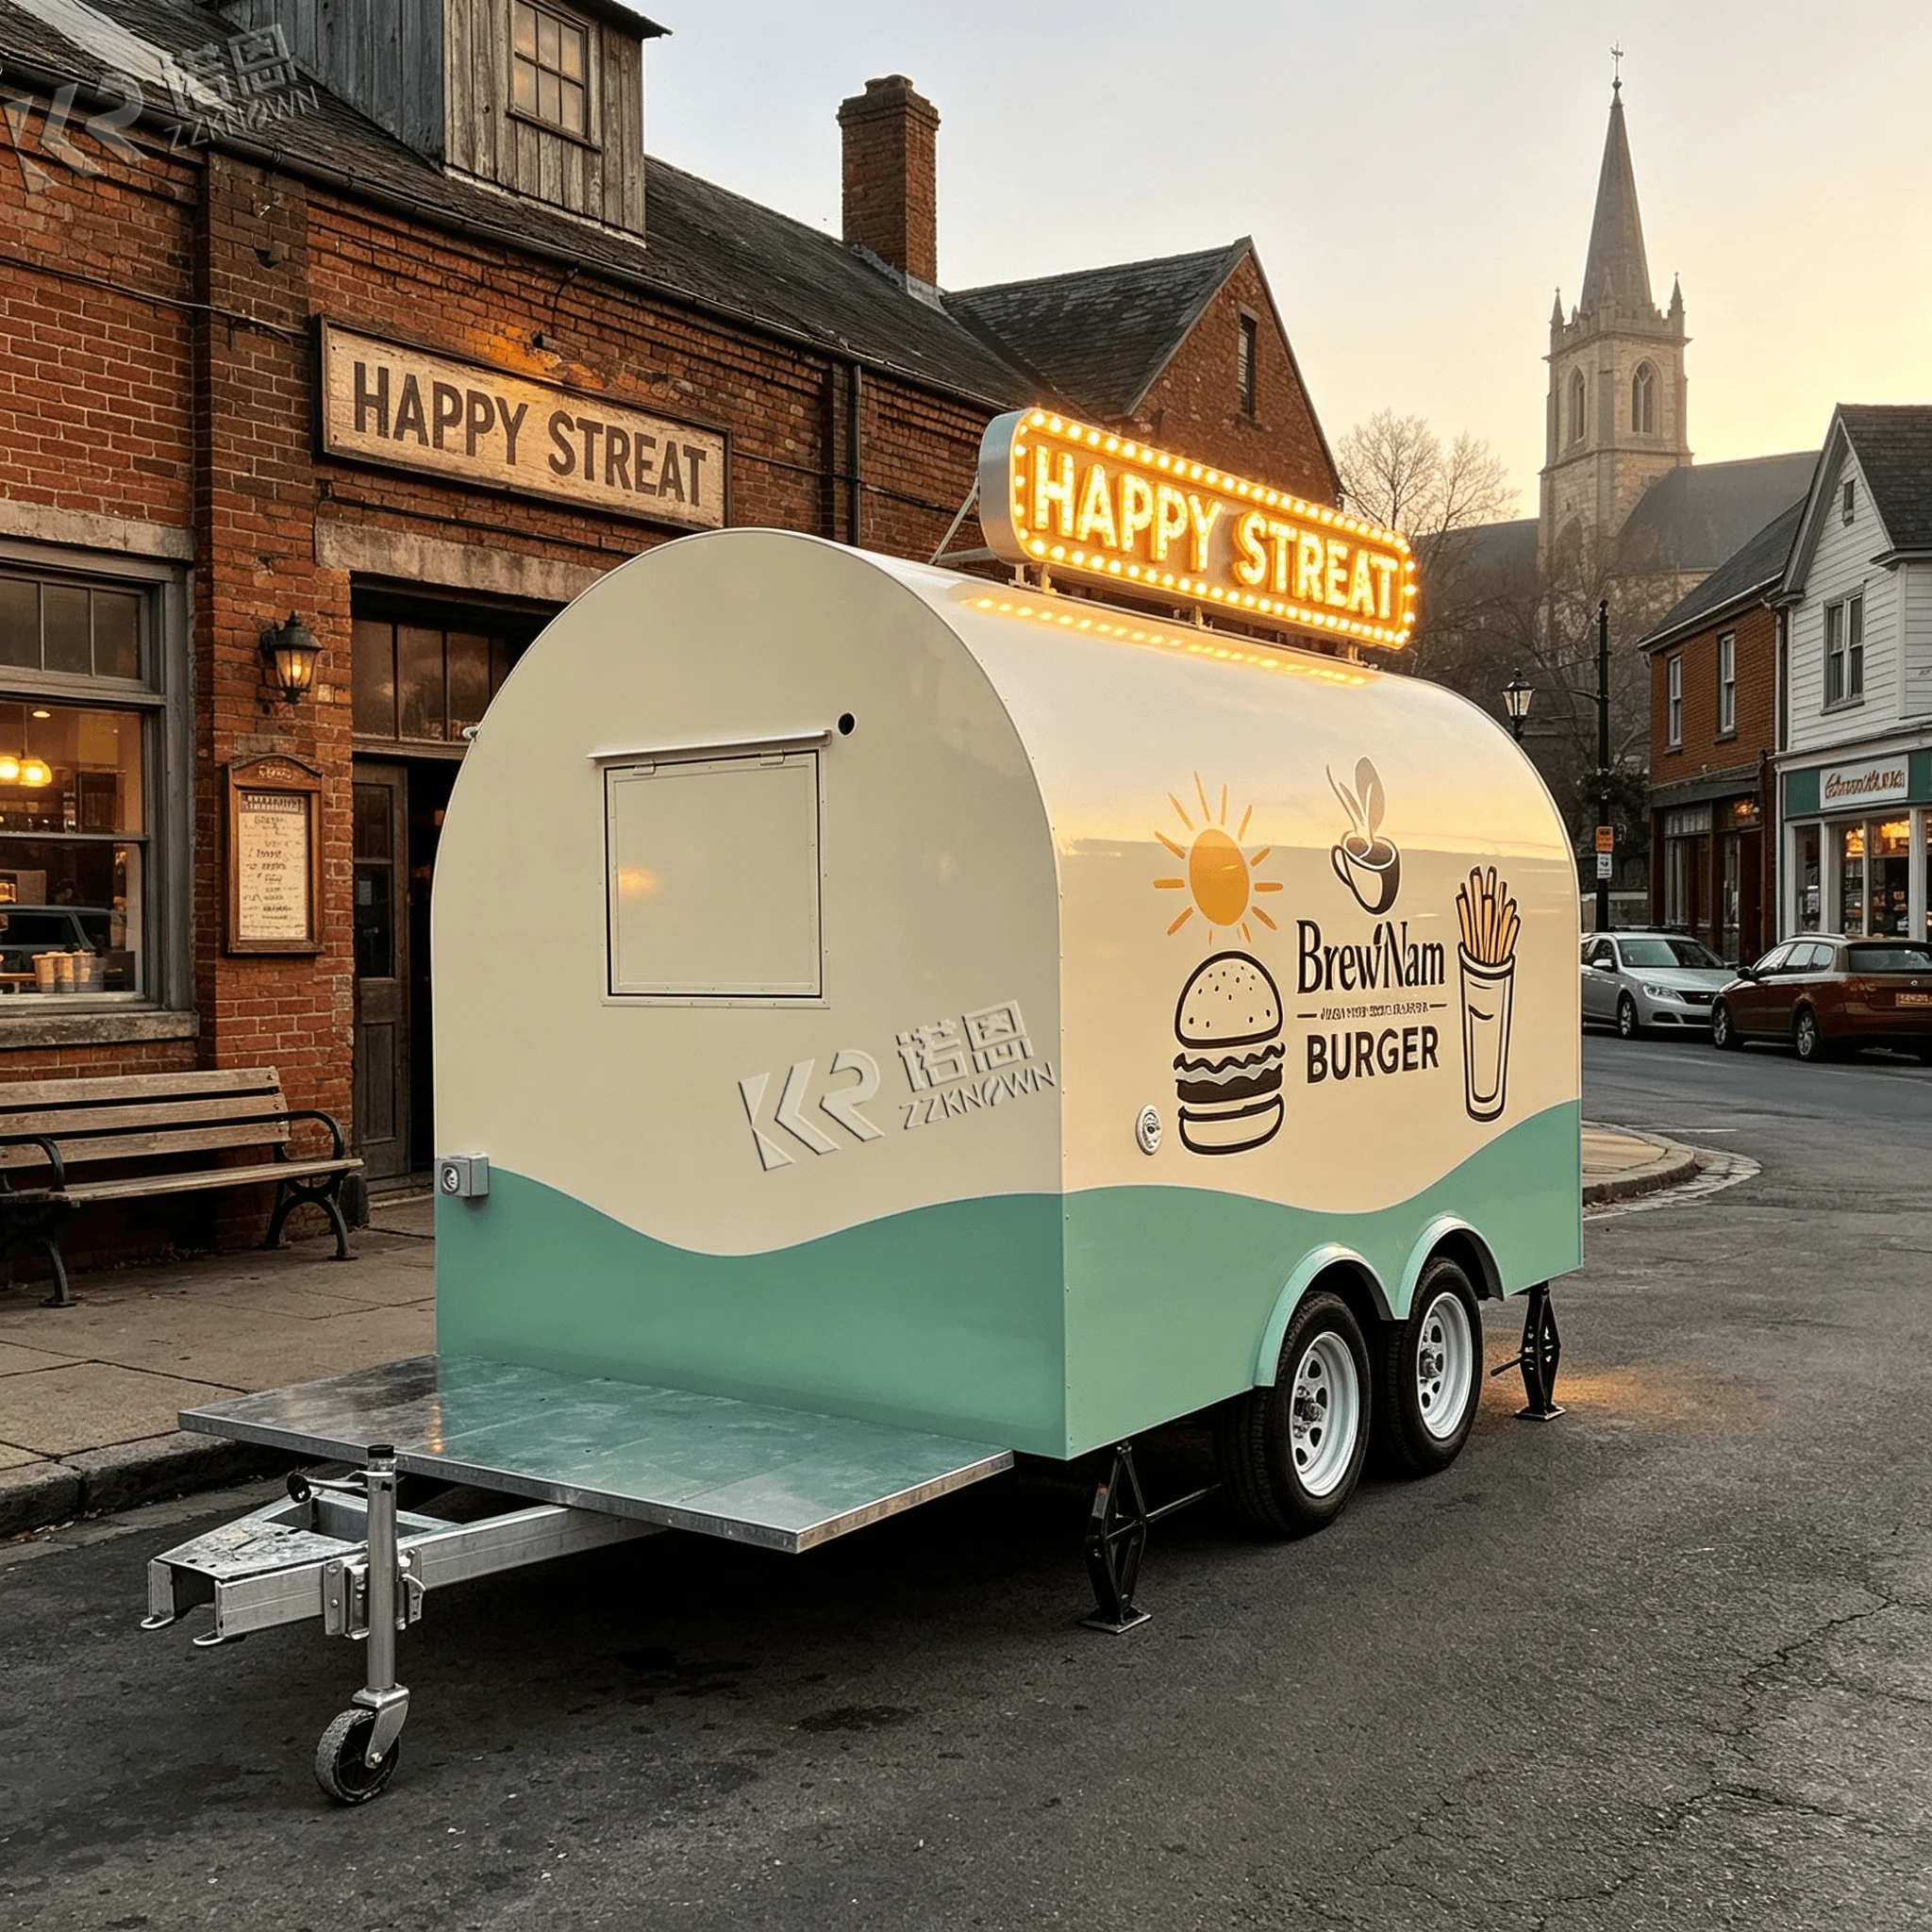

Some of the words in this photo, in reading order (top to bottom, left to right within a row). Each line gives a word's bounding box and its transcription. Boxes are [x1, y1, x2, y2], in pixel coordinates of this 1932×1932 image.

[354, 361, 529, 466] HAPPY
[548, 409, 708, 507] STREAT
[1032, 444, 1224, 573] HAPPY
[1233, 509, 1399, 619] STREAT
[1307, 1025, 1440, 1084] BURGER
